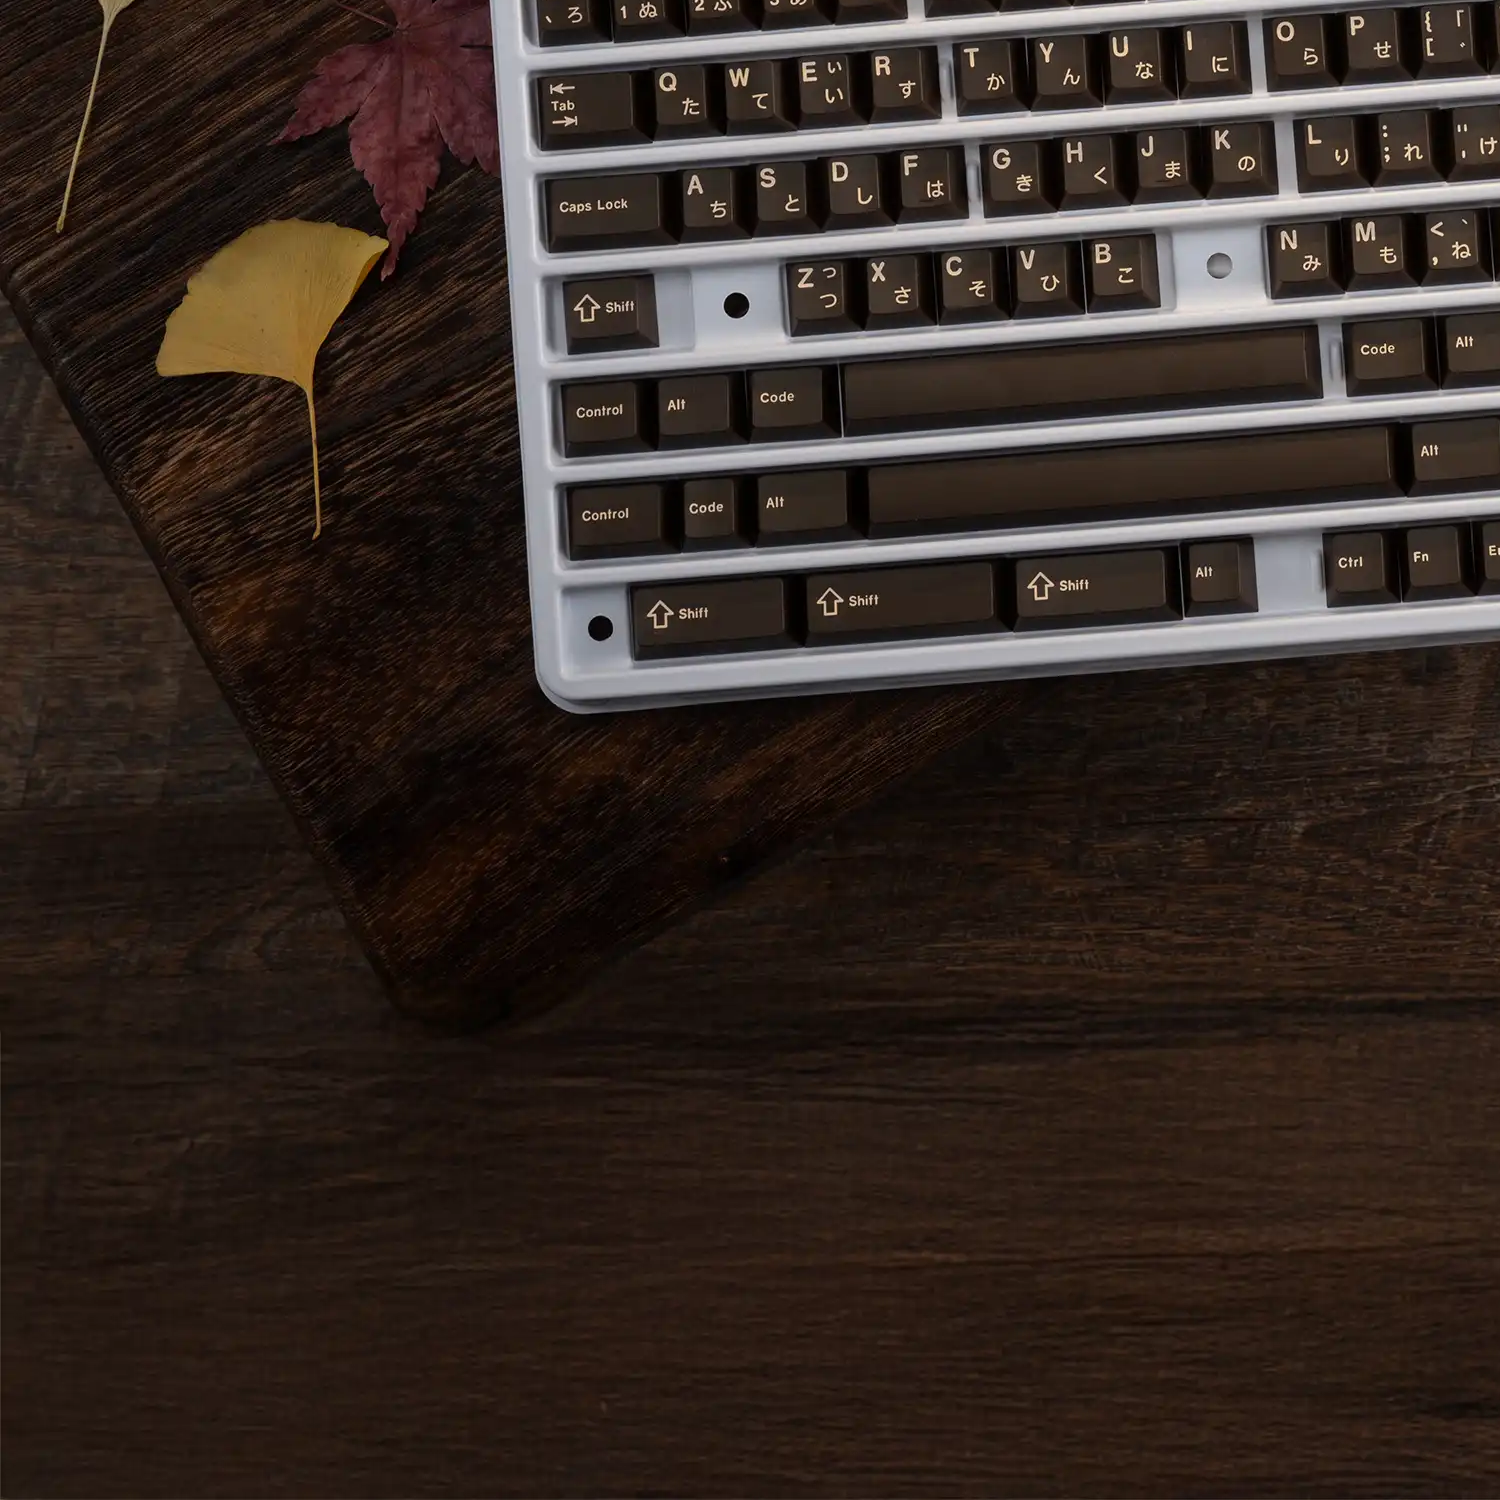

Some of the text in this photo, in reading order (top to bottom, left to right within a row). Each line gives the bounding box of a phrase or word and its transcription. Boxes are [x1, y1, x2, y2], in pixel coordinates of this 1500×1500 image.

[1276, 21, 1294, 42] O
[1350, 16, 1364, 36] P
[1039, 42, 1054, 63] Y
[1112, 36, 1129, 57] U
[1373, 41, 1391, 58] せ
[963, 48, 979, 68] T
[1212, 56, 1229, 73] に
[1304, 48, 1318, 65] ら
[802, 61, 817, 82] E
[875, 56, 891, 76] R
[1135, 62, 1154, 79] な
[659, 72, 677, 92] Q
[729, 68, 749, 87] W
[987, 73, 1005, 91] か
[1063, 68, 1080, 85] ん
[825, 88, 843, 103] い
[899, 80, 916, 99] す
[551, 100, 575, 111] Tab
[682, 97, 700, 115] た
[752, 93, 768, 109] て
[1215, 130, 1231, 150] K
[1308, 124, 1322, 144] L
[1066, 141, 1083, 163] H
[1141, 136, 1153, 157] J
[904, 155, 918, 176] F
[993, 149, 1011, 169] G
[1238, 156, 1255, 171] の
[1335, 148, 1349, 166] り
[760, 168, 776, 188] S
[832, 162, 848, 182] D
[1094, 167, 1107, 184] く
[1165, 161, 1181, 178] ま
[687, 175, 703, 195] A
[927, 180, 944, 198] は
[1016, 174, 1033, 192] き
[785, 194, 800, 212] と
[857, 187, 873, 204] し
[559, 198, 628, 214] Caps Lock
[710, 200, 726, 218] ち
[1280, 230, 1297, 250] N
[1355, 221, 1376, 242] M
[1020, 249, 1035, 270] V
[1095, 243, 1111, 264] B
[1380, 246, 1397, 263] も
[871, 261, 886, 282] X
[946, 256, 962, 276] C
[1303, 255, 1321, 271] み
[797, 268, 814, 288] Z
[1040, 275, 1060, 291] ひ
[1118, 267, 1134, 283] こ
[894, 286, 911, 304] さ
[969, 280, 986, 297] そ
[606, 301, 634, 313] Shift
[820, 294, 837, 308] つ
[1361, 343, 1395, 355] Code
[1456, 336, 1473, 348] Alt
[668, 399, 686, 411] Alt
[760, 391, 794, 403] Code
[576, 404, 623, 418] Control
[1421, 445, 1438, 457] Alt
[689, 502, 723, 514] Code
[766, 496, 784, 508] Alt
[582, 508, 629, 521] Control
[1338, 556, 1363, 568] Ctrl
[1413, 551, 1429, 562] Fn
[1196, 566, 1212, 578] Alt
[1060, 579, 1089, 591] Shift
[849, 594, 878, 607] Shift
[679, 607, 708, 619] Shift
